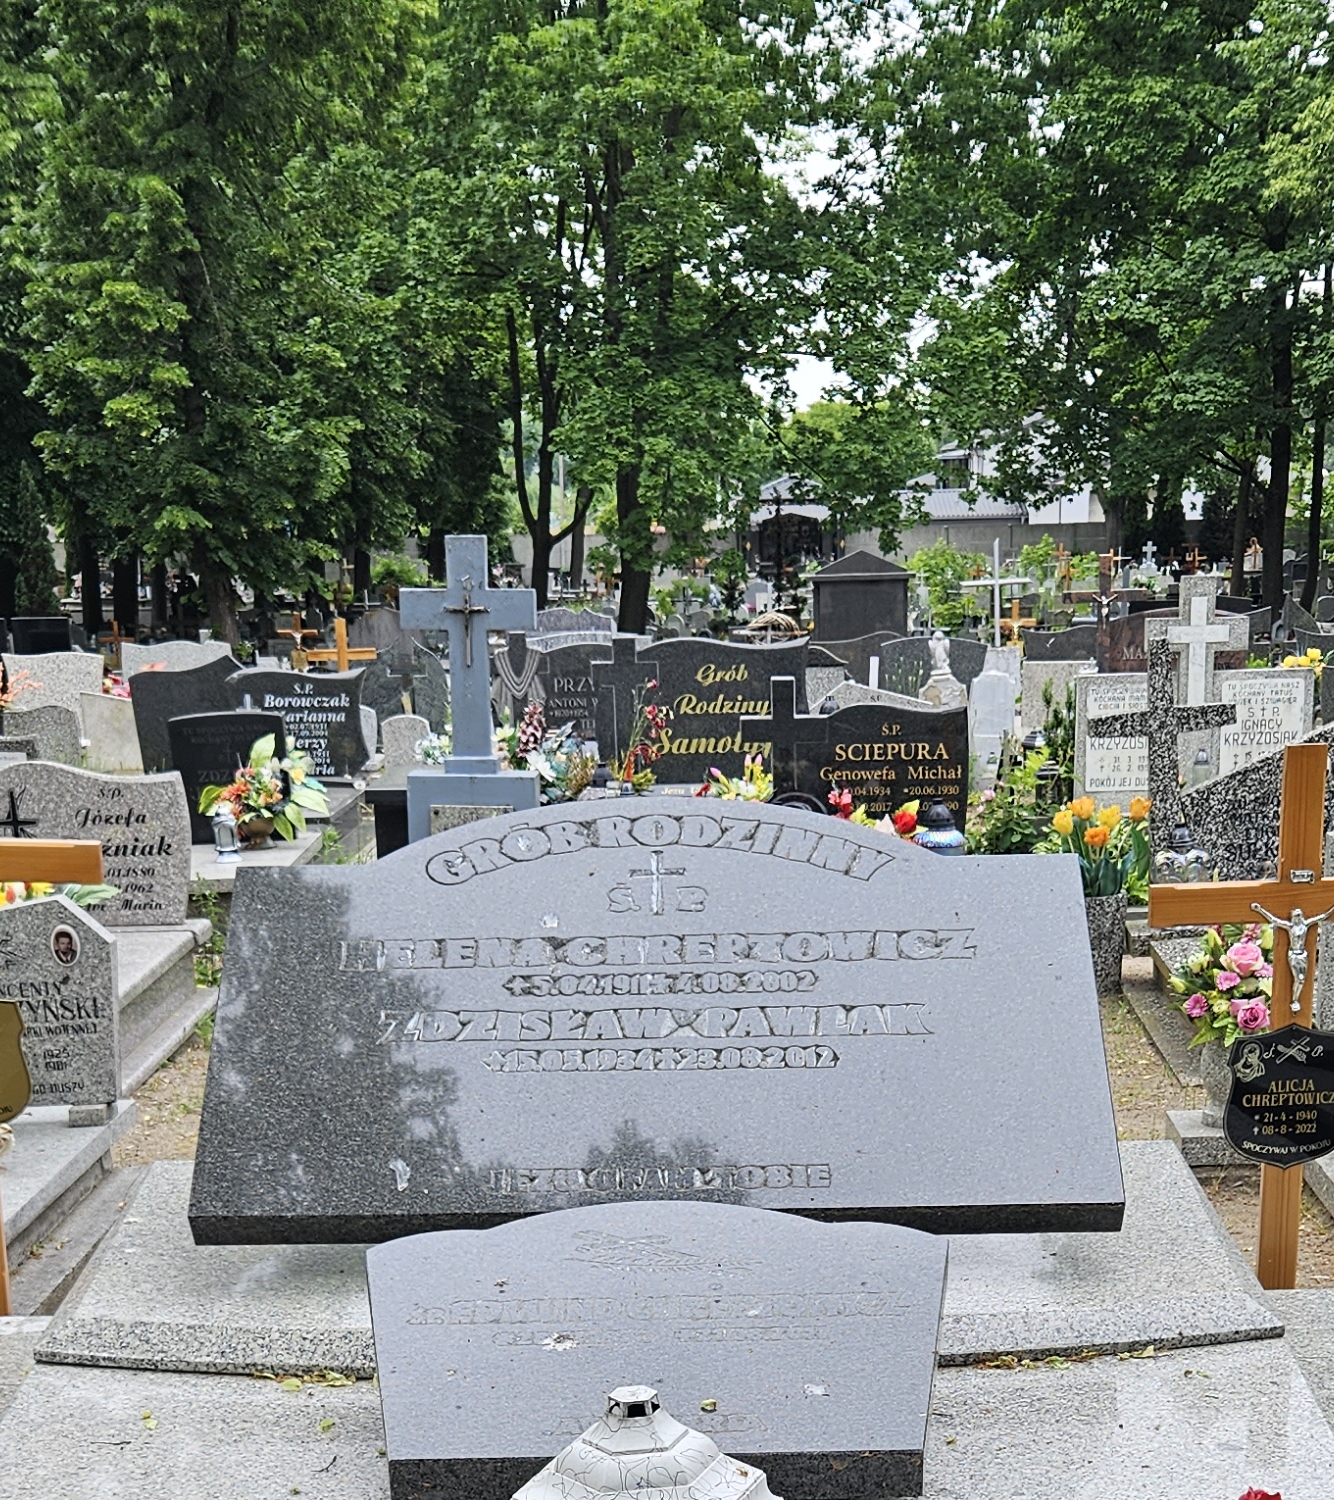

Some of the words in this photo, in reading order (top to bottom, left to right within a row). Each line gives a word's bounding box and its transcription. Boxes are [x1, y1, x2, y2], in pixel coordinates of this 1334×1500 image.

[694, 664, 749, 686] Grób
[264, 693, 350, 708] Borowczak
[674, 694, 772, 716] Rodziny
[281, 711, 346, 723] arianna
[1241, 719, 1282, 730] IGNACY
[835, 743, 949, 761] SCIEPURA
[820, 766, 896, 781] Genowefa
[908, 765, 962, 780] Michał
[75, 808, 147, 829] Józefa
[425, 823, 586, 886] GRÓB
[597, 814, 896, 882] RODZINNY
[339, 936, 553, 972] HELENA
[566, 928, 978, 967] CHREPTOWICZ
[377, 1008, 671, 1045] ZDZISŁAW
[701, 1004, 934, 1038] PAWLAK
[1268, 1079, 1315, 1093] ALICJA
[1242, 1140, 1288, 1154] SPOCZYWAJ
[1300, 1139, 1331, 1152] POKOJU
